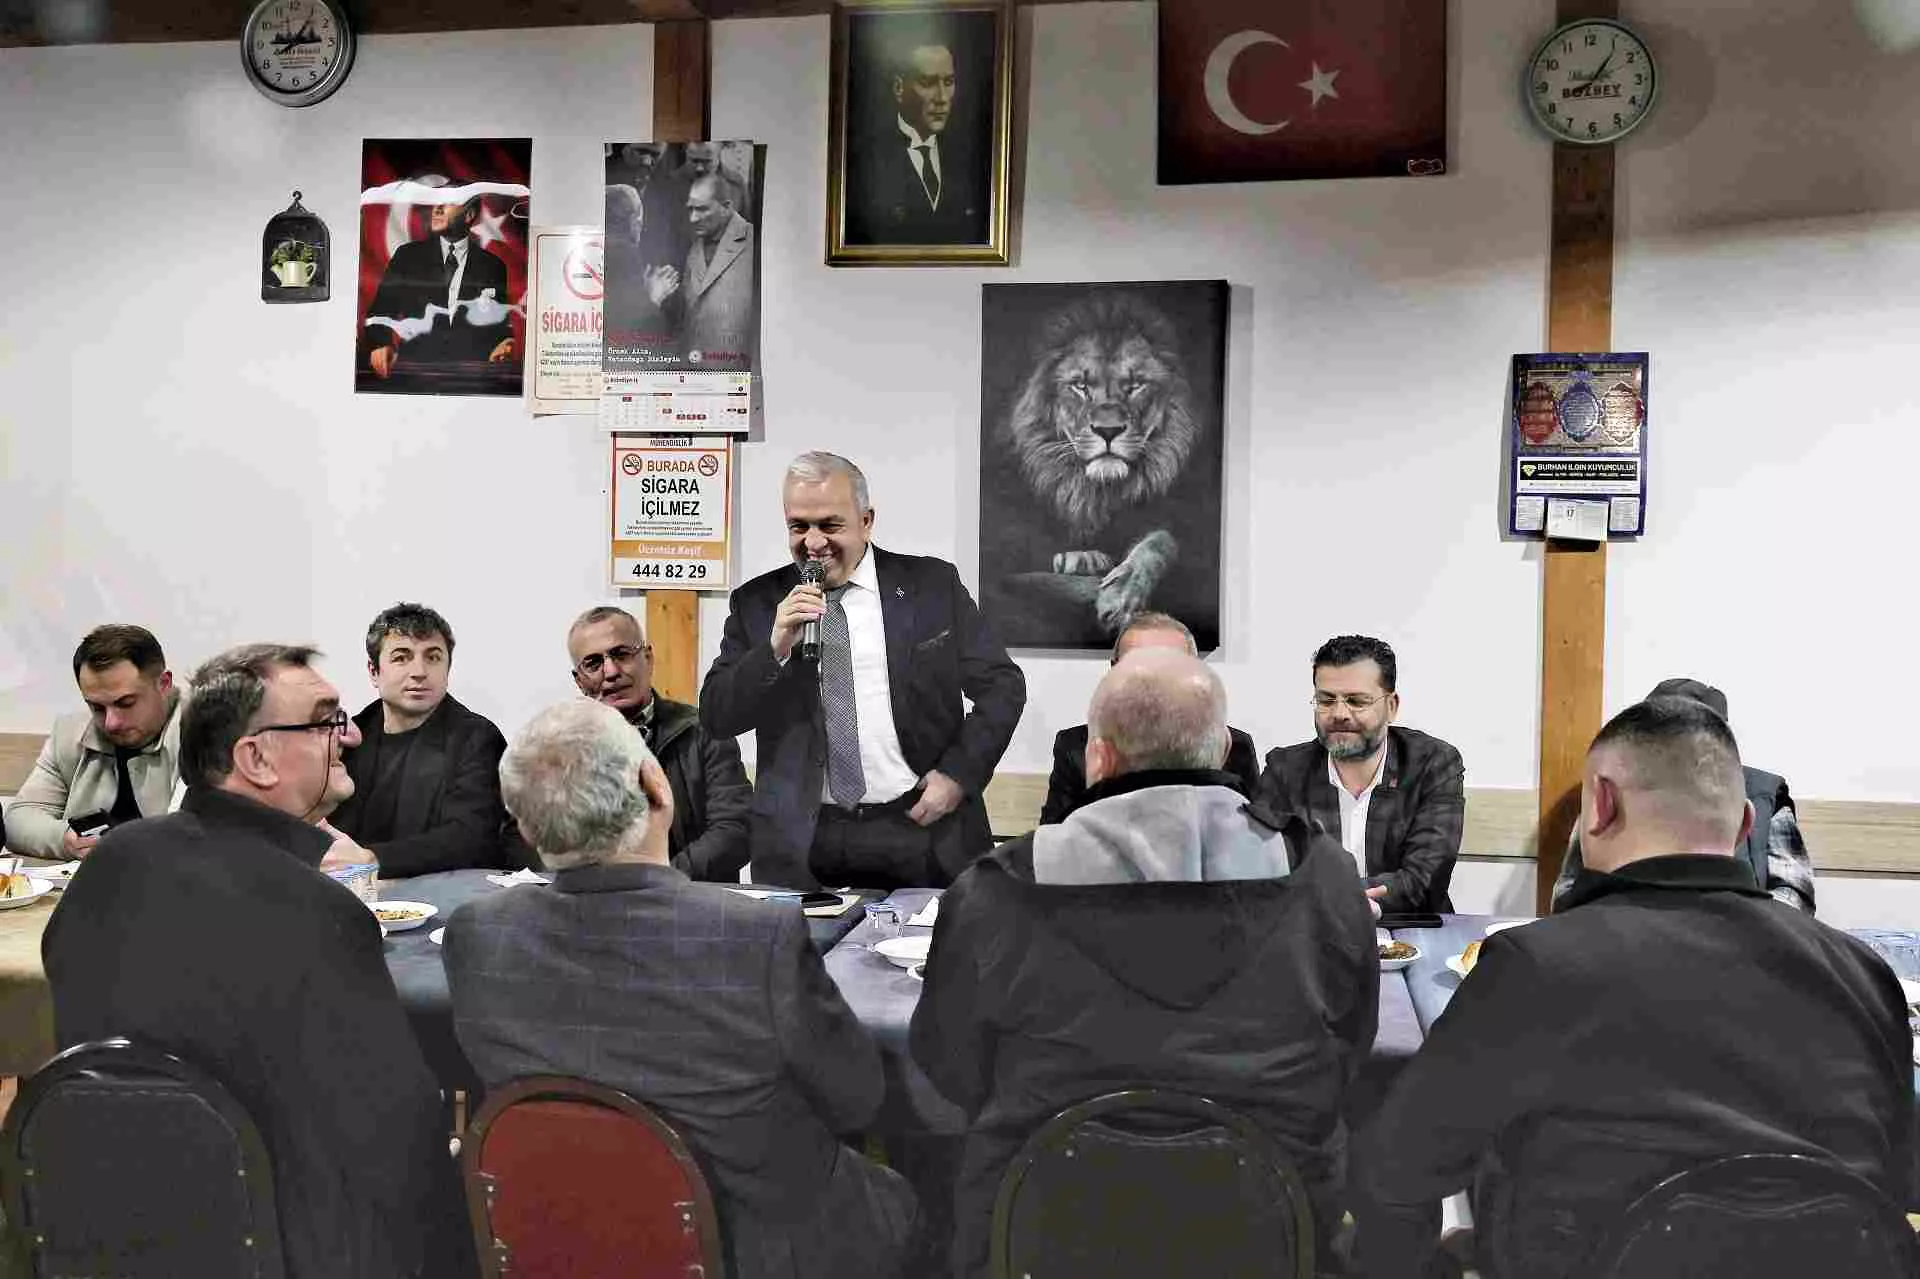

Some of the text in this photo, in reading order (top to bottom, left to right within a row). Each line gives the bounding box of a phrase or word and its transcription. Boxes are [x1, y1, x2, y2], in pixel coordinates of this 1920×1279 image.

[321, 18, 328, 28] 2
[257, 40, 264, 49] 9
[1584, 35, 1596, 47] 12
[1563, 41, 1572, 54] 11
[1626, 52, 1634, 63] 2
[263, 60, 270, 69] 8
[1546, 59, 1559, 71] 10
[275, 72, 282, 81] 7
[309, 71, 317, 80] 5
[1634, 74, 1642, 85] 3
[292, 77, 300, 86] 6
[1540, 81, 1549, 94] 9
[1628, 95, 1636, 105] 4
[1549, 103, 1556, 114] 8
[1567, 118, 1574, 128] 7
[1614, 113, 1621, 127] 5
[1588, 122, 1596, 133] 6
[542, 306, 586, 332] SİGARA
[647, 460, 695, 472] BURADA
[1537, 463, 1567, 471] BURHAN
[641, 475, 700, 494] SİGARA
[641, 497, 700, 519] İÇİLMEZ
[632, 564, 706, 578] 444 82 29
